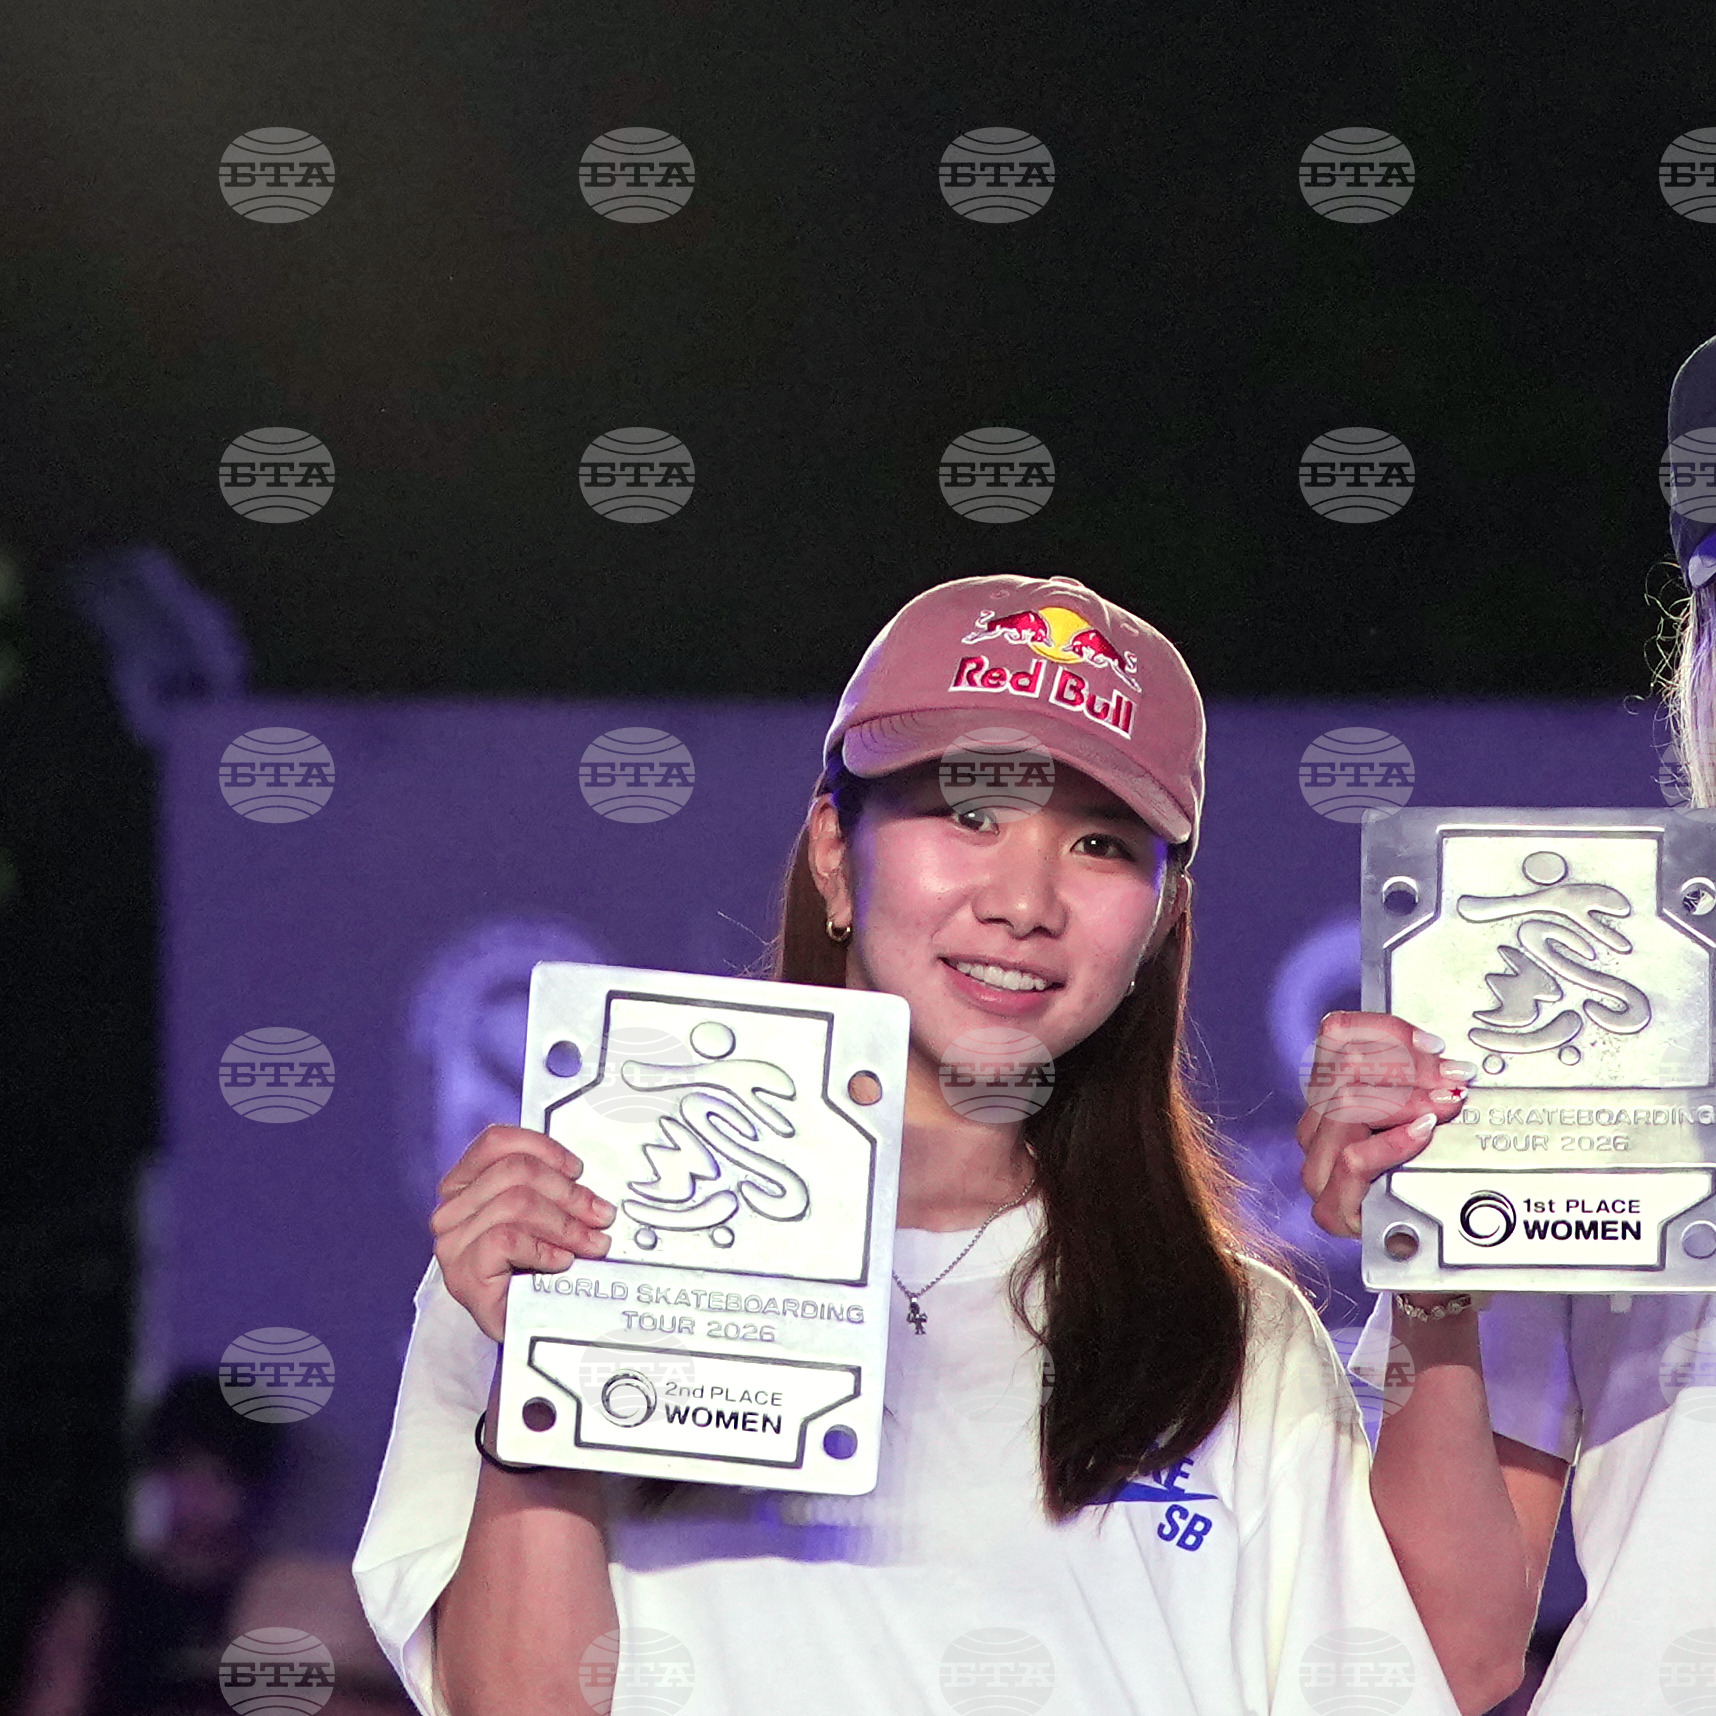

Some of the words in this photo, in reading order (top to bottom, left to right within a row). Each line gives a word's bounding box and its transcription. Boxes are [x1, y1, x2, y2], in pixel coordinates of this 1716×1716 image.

[948, 655, 1047, 699] Red
[1048, 664, 1137, 740] Bull
[1488, 1107, 1716, 1126] SKATEBOARDING
[1476, 1133, 1549, 1153] TOUR
[1561, 1134, 1631, 1153] 2026
[1523, 1198, 1555, 1214] 1st
[1566, 1198, 1641, 1215] PLACE
[1523, 1219, 1642, 1242] WOMEN
[530, 1272, 629, 1302] WORLD
[636, 1282, 866, 1325] SKATEBOARDING
[622, 1310, 696, 1335] TOUR
[706, 1319, 777, 1343] 2026
[664, 1381, 705, 1400] 2nd
[710, 1386, 784, 1408] PLACE
[664, 1404, 783, 1436] WOMEN
[1157, 1503, 1213, 1552] SB
